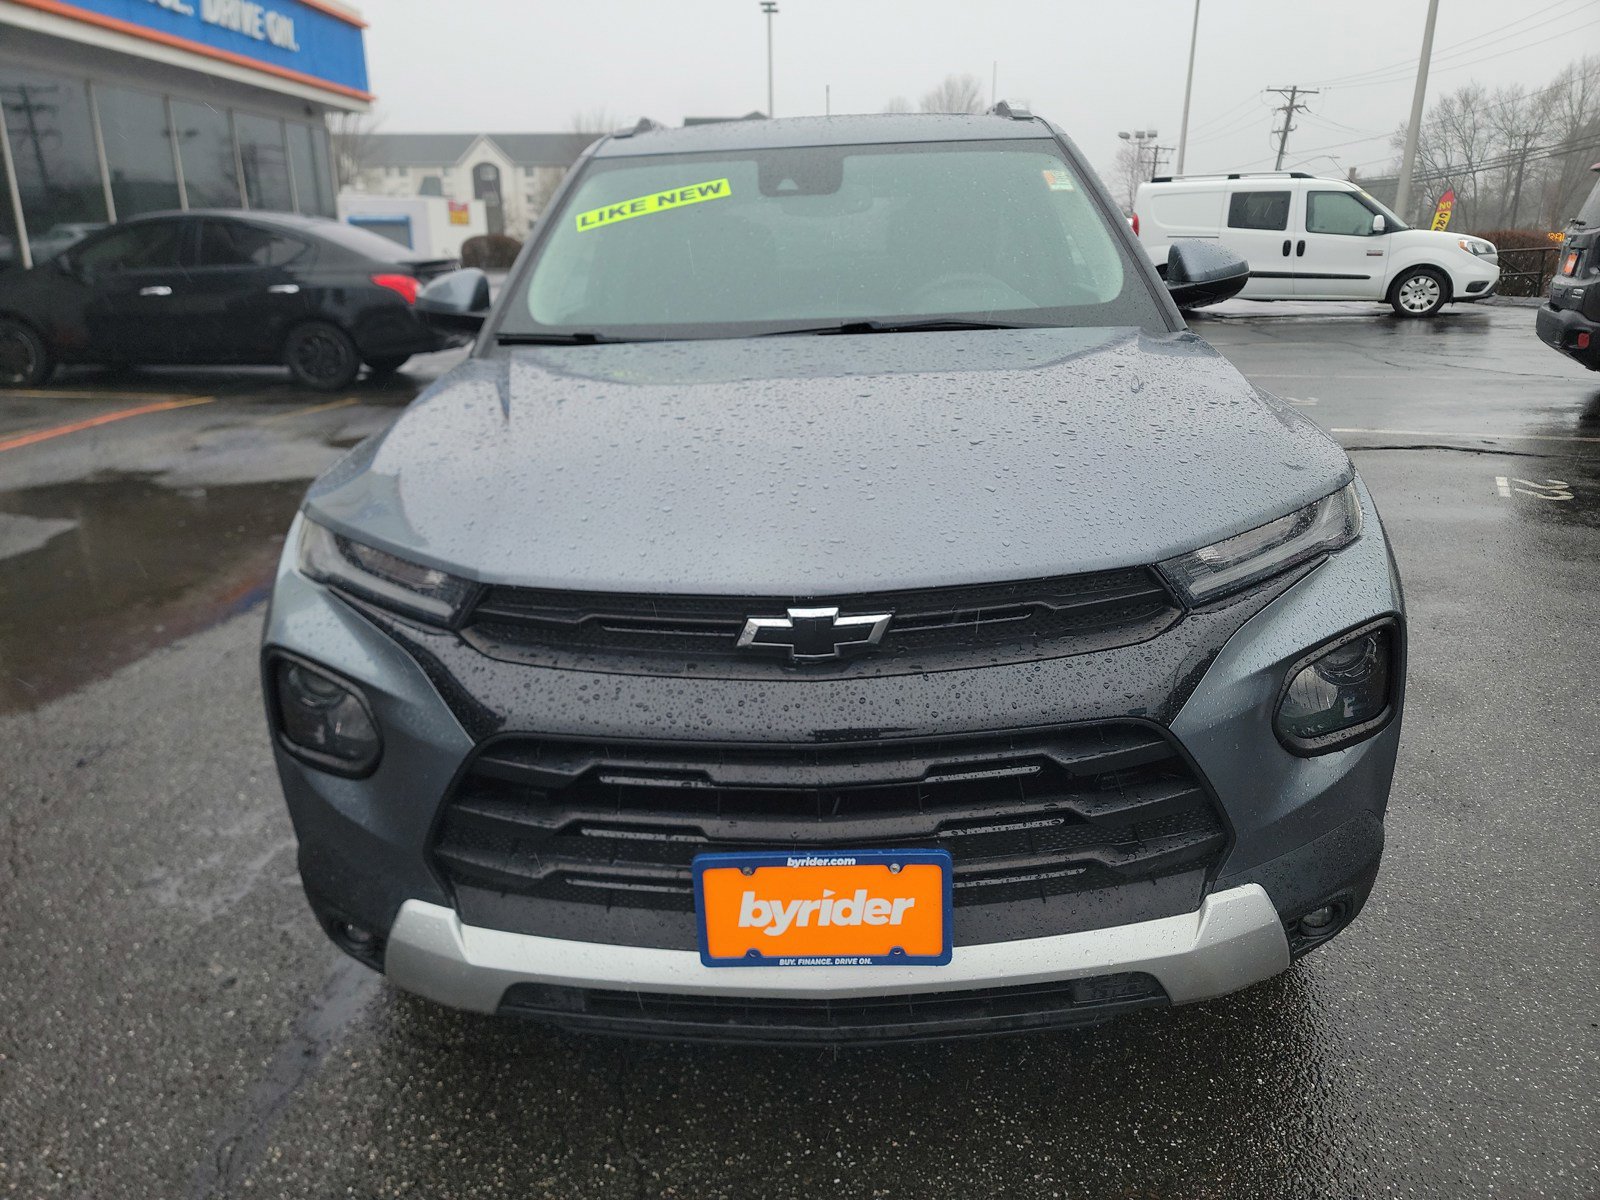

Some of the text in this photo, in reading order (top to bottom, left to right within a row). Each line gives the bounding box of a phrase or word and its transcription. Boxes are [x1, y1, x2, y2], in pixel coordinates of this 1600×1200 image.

[580, 181, 722, 228] LIKE NEW
[786, 856, 857, 869] byrider.com
[737, 888, 916, 937] byrider
[779, 957, 873, 966] BUY. FINANCE. DRIVE ON.
